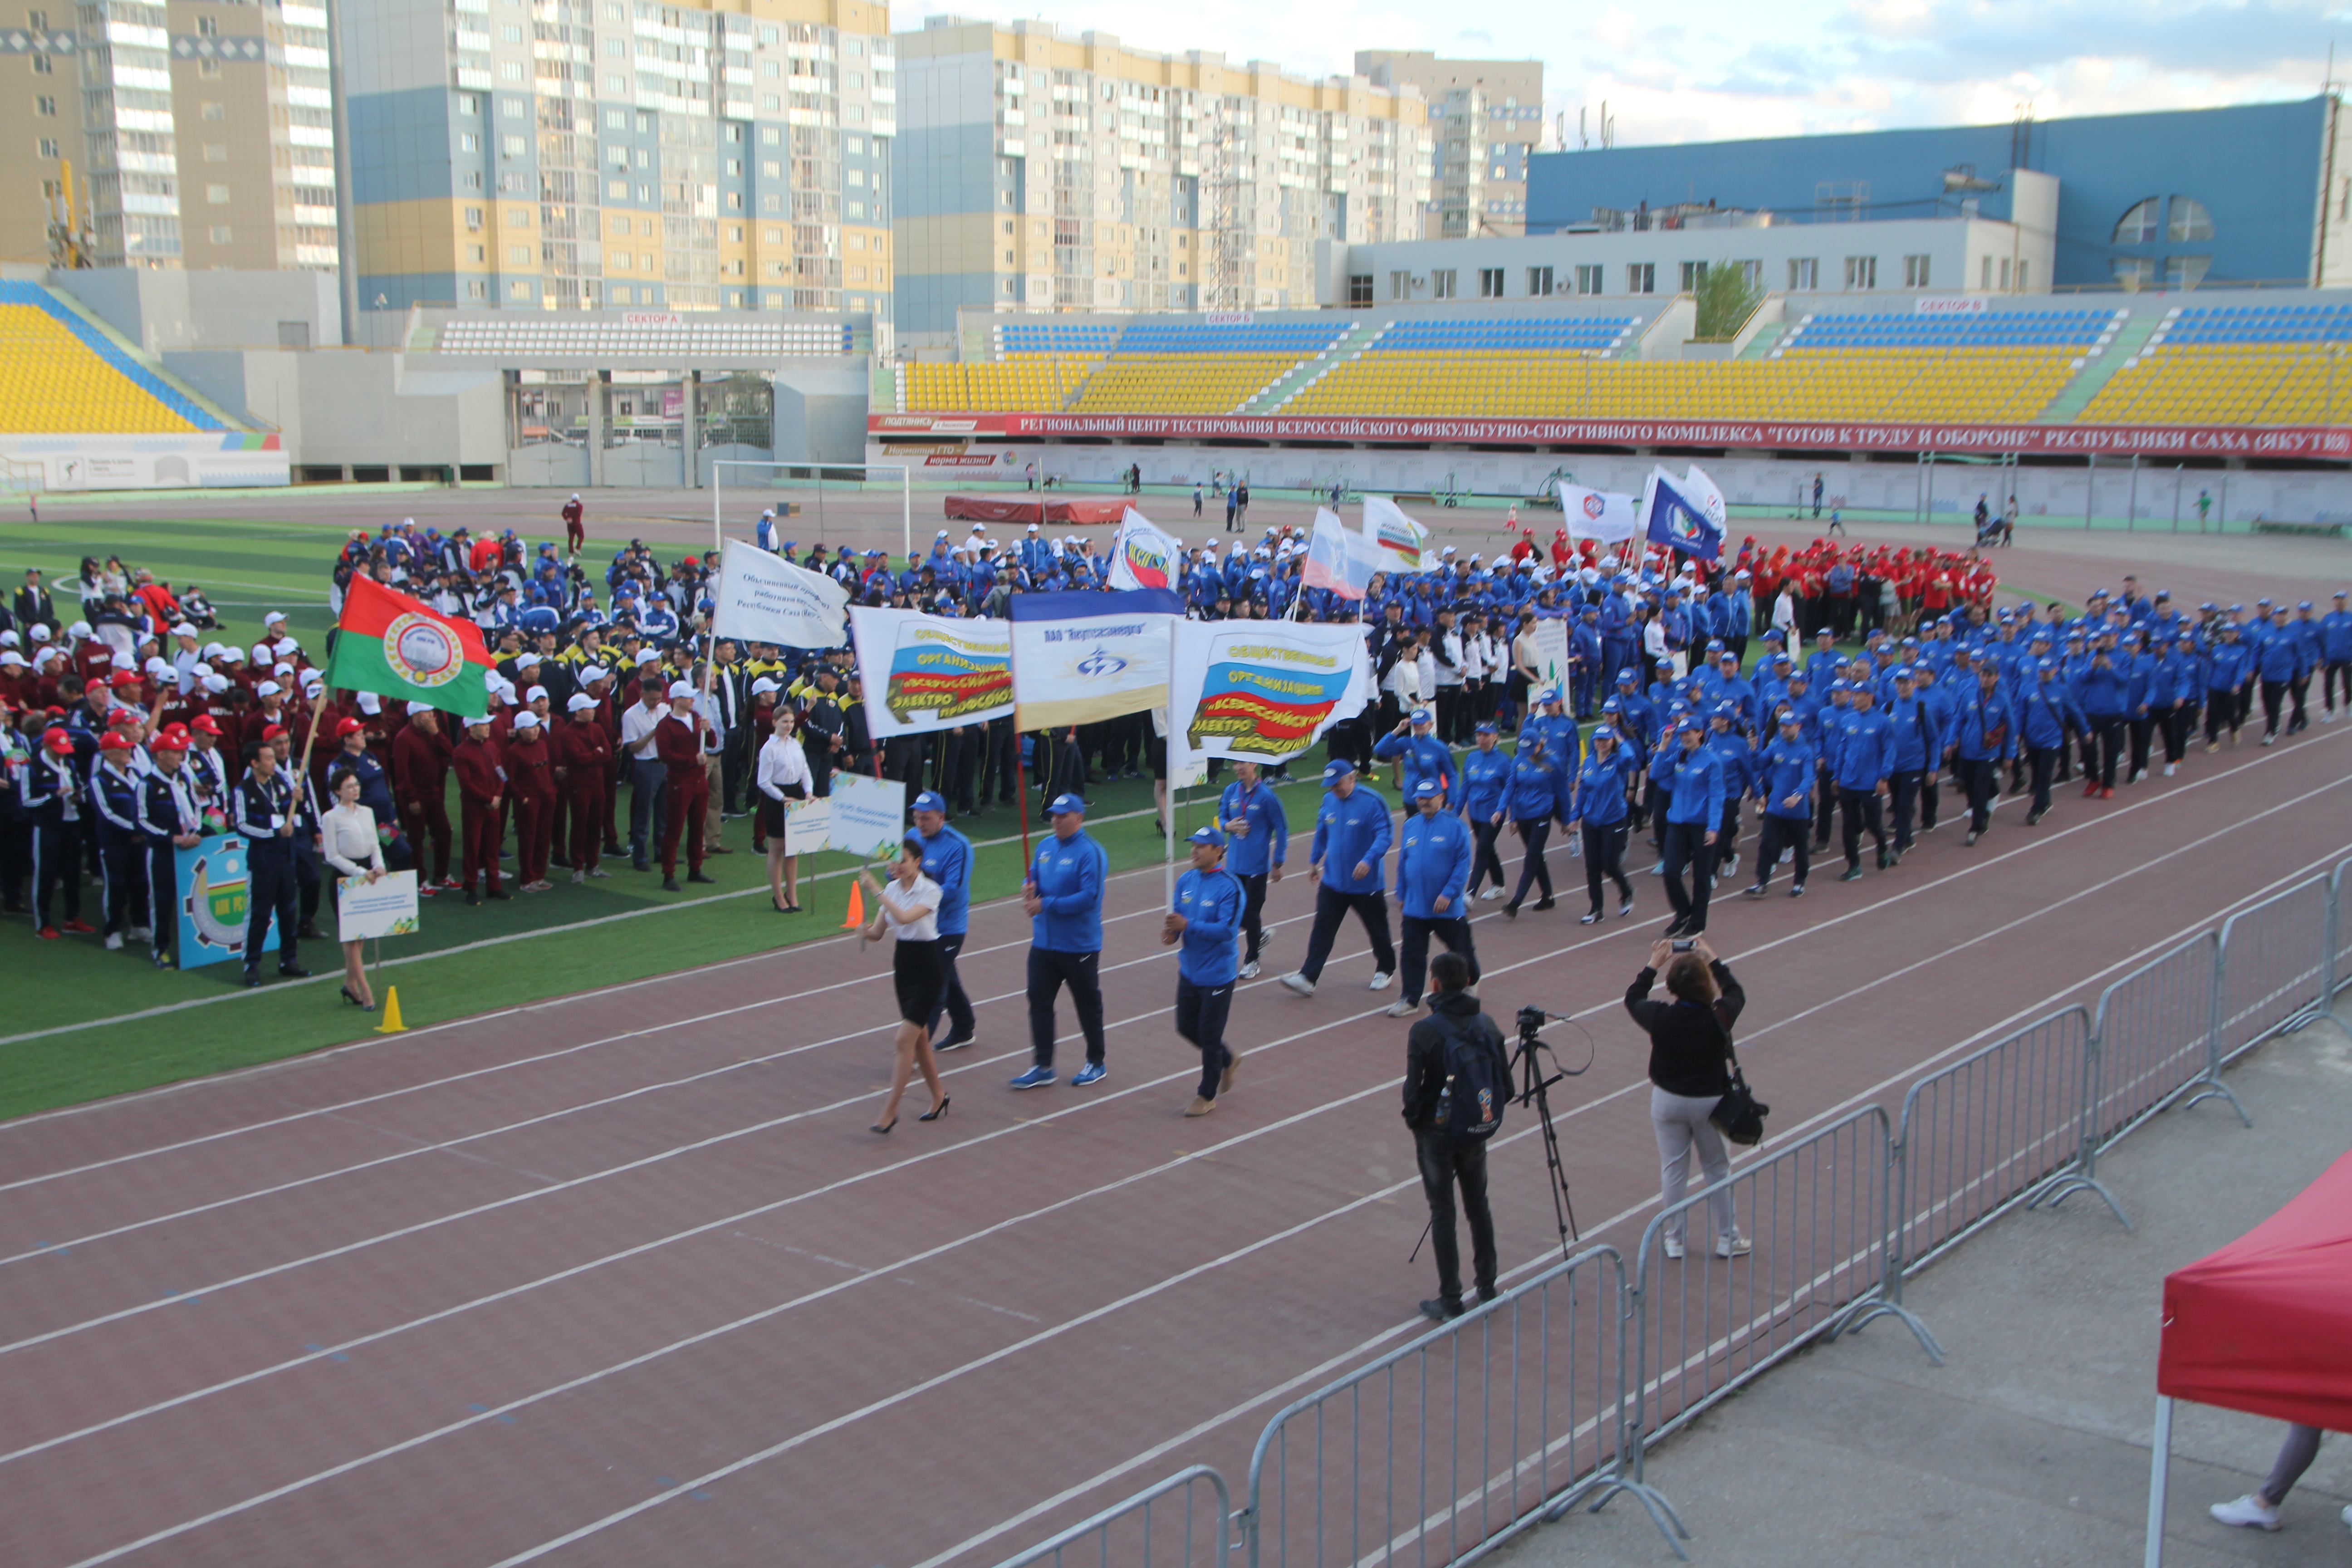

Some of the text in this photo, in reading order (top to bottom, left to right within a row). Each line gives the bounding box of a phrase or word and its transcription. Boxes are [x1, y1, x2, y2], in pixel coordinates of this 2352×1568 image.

[1921, 300, 1970, 312] СЕКТОР
[627, 314, 678, 323] СЕКТОР А
[1209, 313, 1250, 324] СЕКТОР Б
[885, 416, 932, 426] ПОДТЯНИСЬ
[1020, 415, 2350, 452] РЕГИОНАЛЬНЫЙ ЦЕНТР ТЕСТИРОВАНИЯ ВСЕРОССИЙСКОГО ФИЗКУЛЬТУРНО-СПОРТИВНОГО КОМПЛЕКСА "ГОТОВ К ТРУДУ И ОБОРОНЕ" РЕСПУБЛИКИ САХА (ЯКУТИЯ)
[888, 446, 934, 456] Норматив
[937, 446, 954, 455] ГТО
[930, 456, 991, 466] норма жизни!
[743, 573, 799, 591] Объединенный
[1228, 645, 1337, 667] ОБЩЕСТВЕННАЯ
[1228, 671, 1324, 697] ОРГАНИЗАЦИЯ
[892, 693, 954, 709] ЭЛЕКТРО
[1191, 718, 1252, 732] ЭЛЕКТРО
